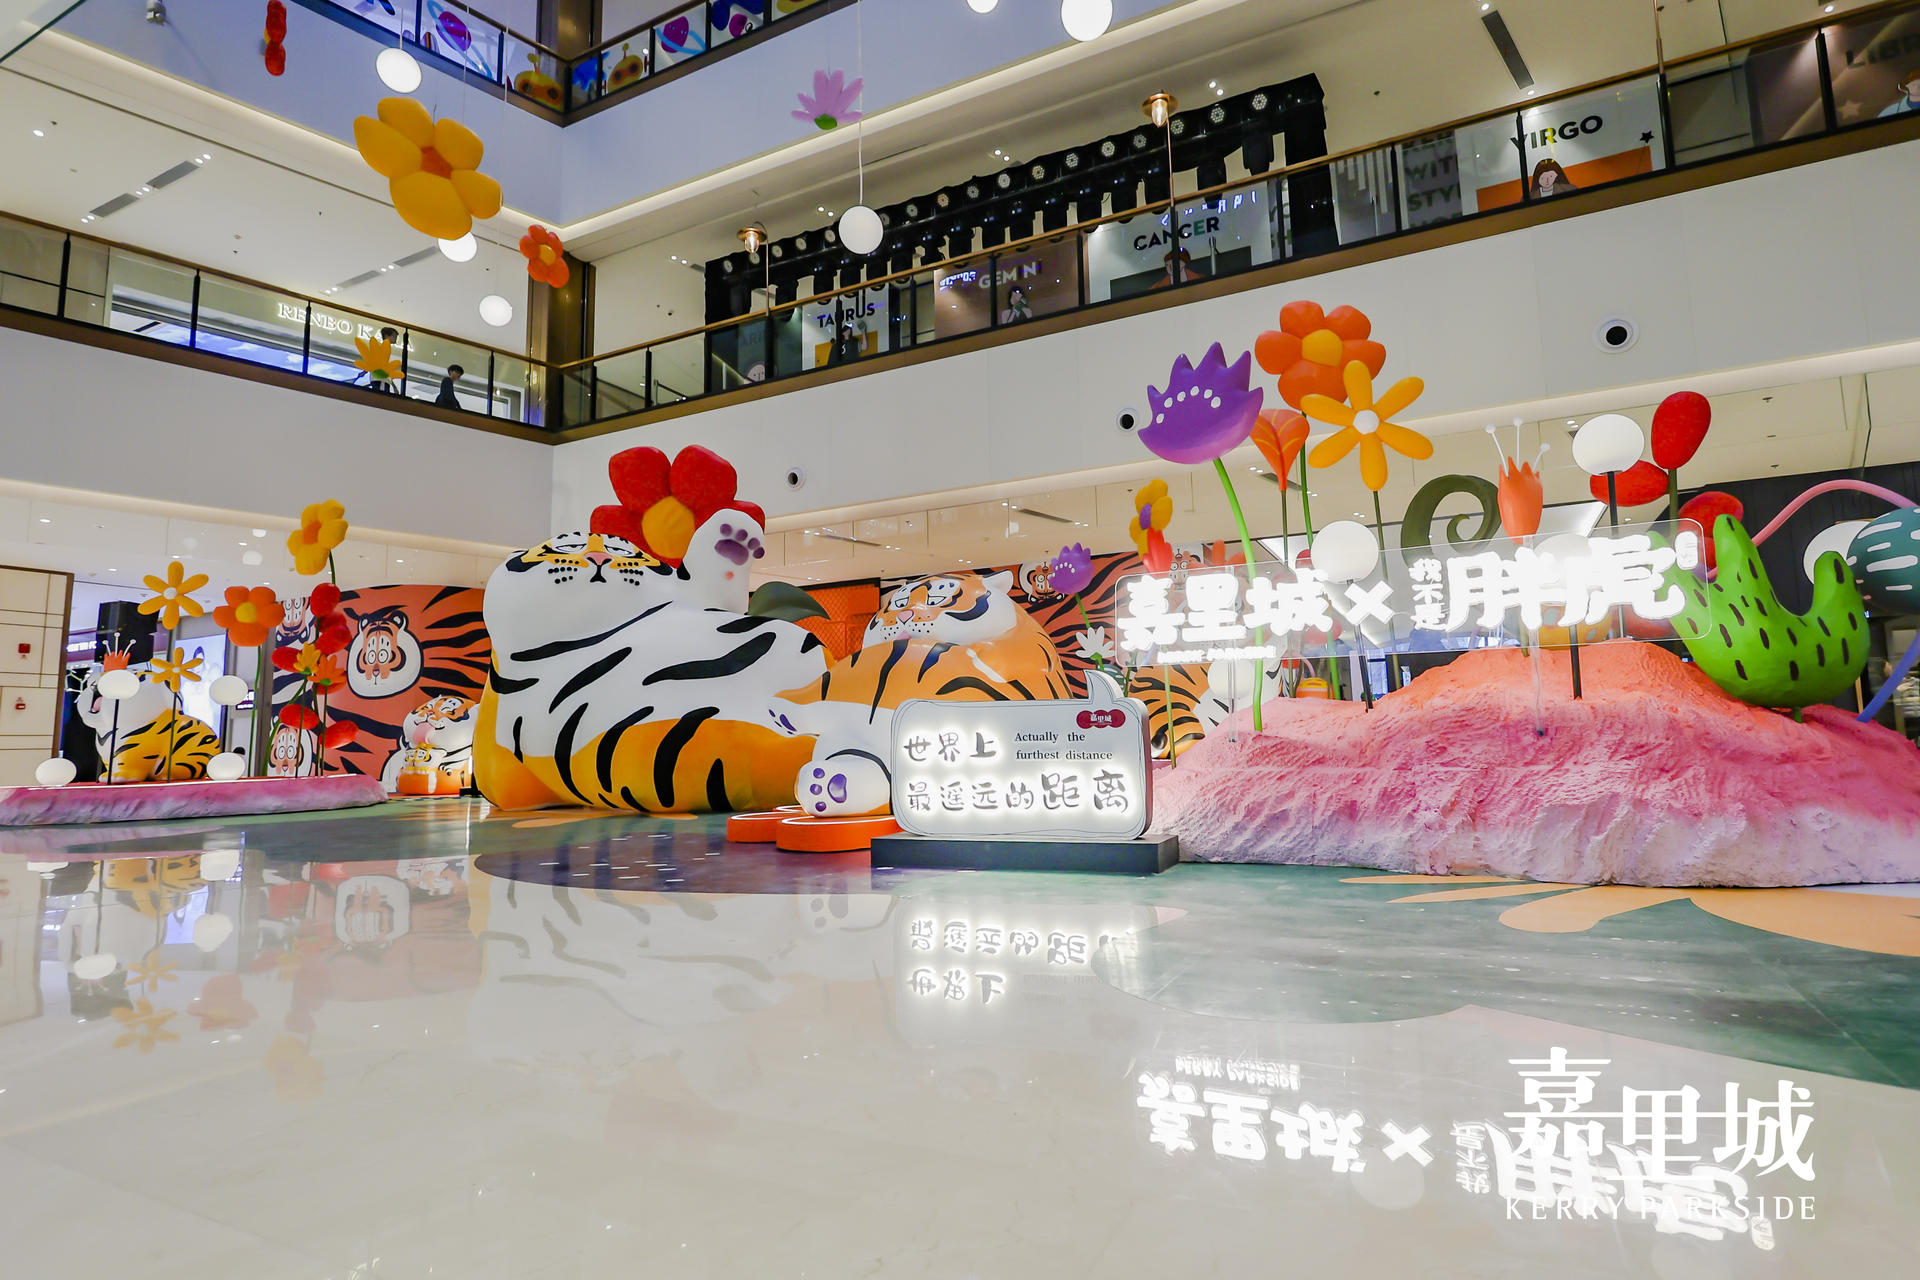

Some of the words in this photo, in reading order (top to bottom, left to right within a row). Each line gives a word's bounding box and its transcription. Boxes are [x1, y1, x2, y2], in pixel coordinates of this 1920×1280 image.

[1510, 115, 1603, 151] VIRGO
[1133, 216, 1220, 251] CANCER
[277, 302, 353, 335] RENBO
[903, 731, 997, 762] 世界上
[1014, 731, 1060, 744] Actually
[1067, 731, 1086, 742] the
[1016, 750, 1060, 760] furthest
[1065, 750, 1113, 760] distance
[907, 769, 1129, 813] 最遥远的距离
